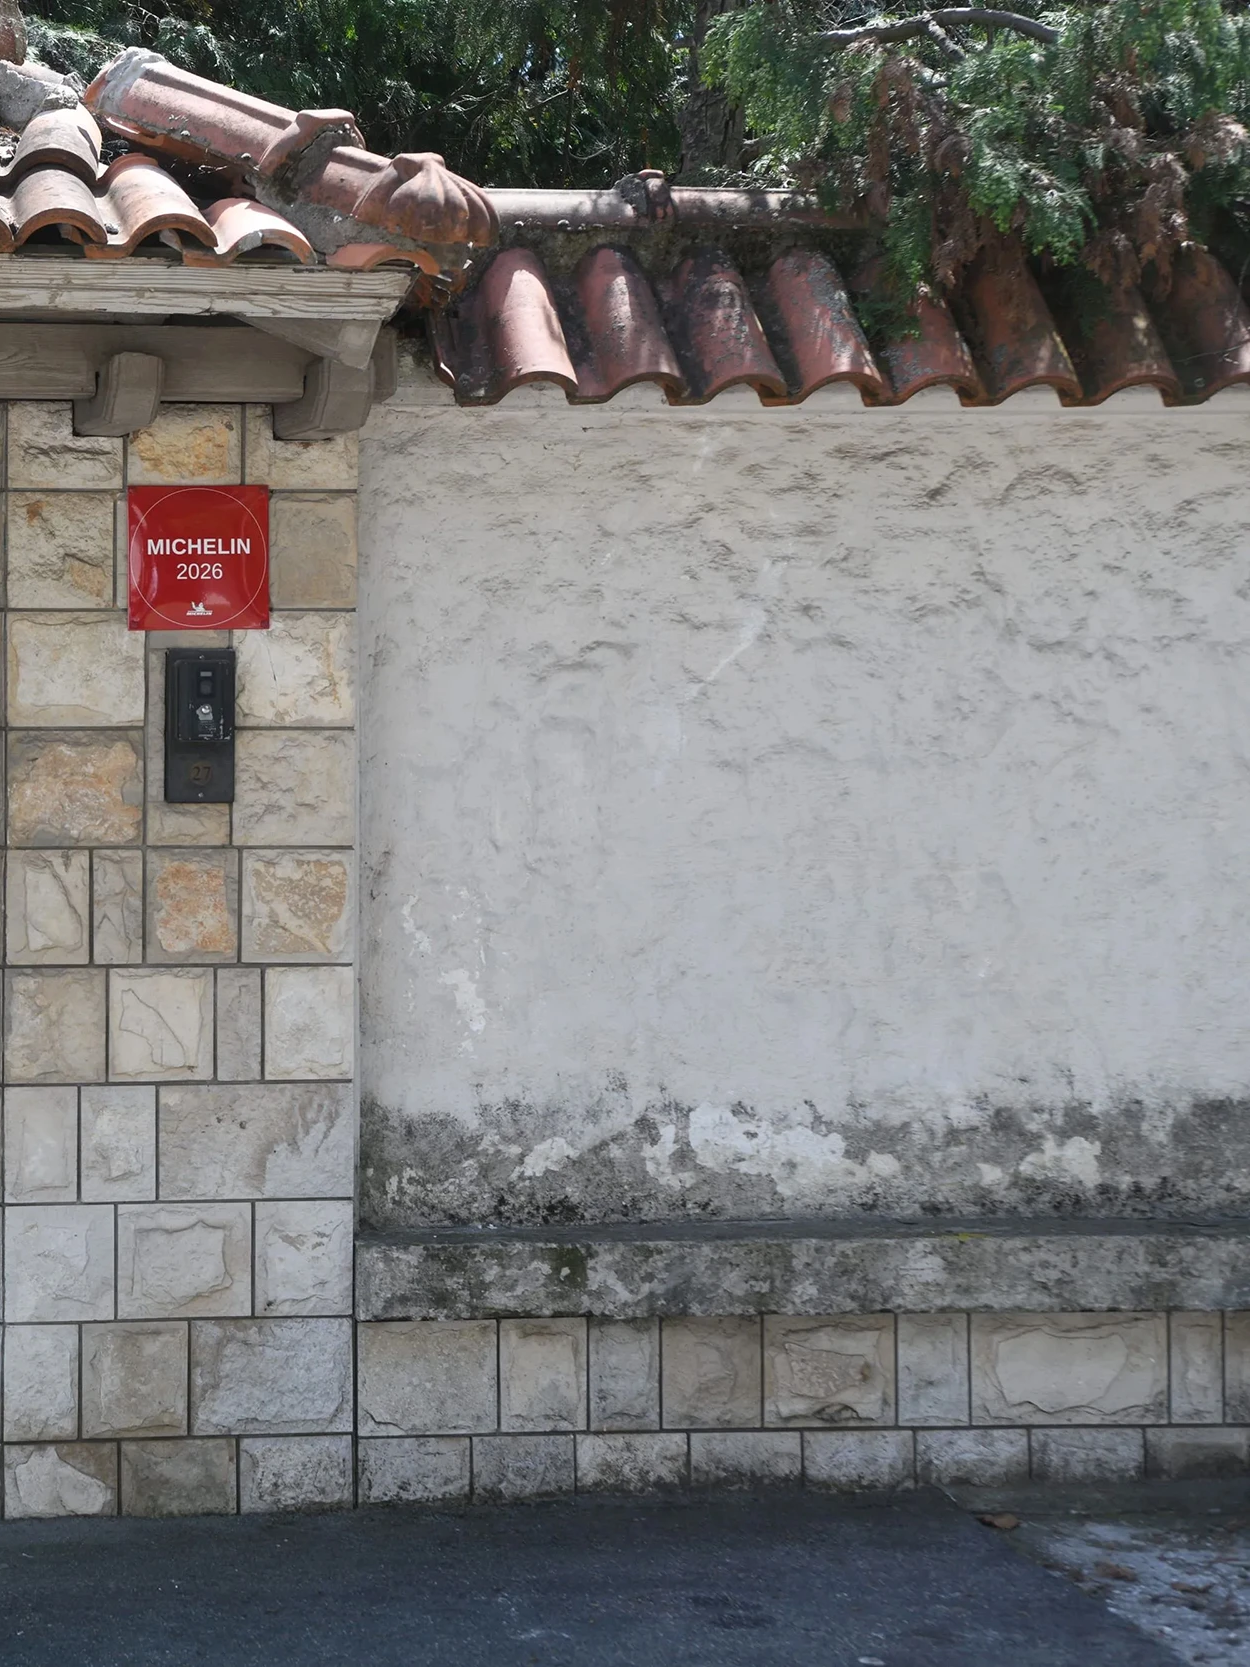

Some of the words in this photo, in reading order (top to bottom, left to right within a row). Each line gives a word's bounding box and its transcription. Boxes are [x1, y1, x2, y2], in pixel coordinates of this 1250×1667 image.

[147, 538, 251, 555] MICHELIN
[176, 563, 223, 580] 2026
[192, 765, 211, 782] 27
